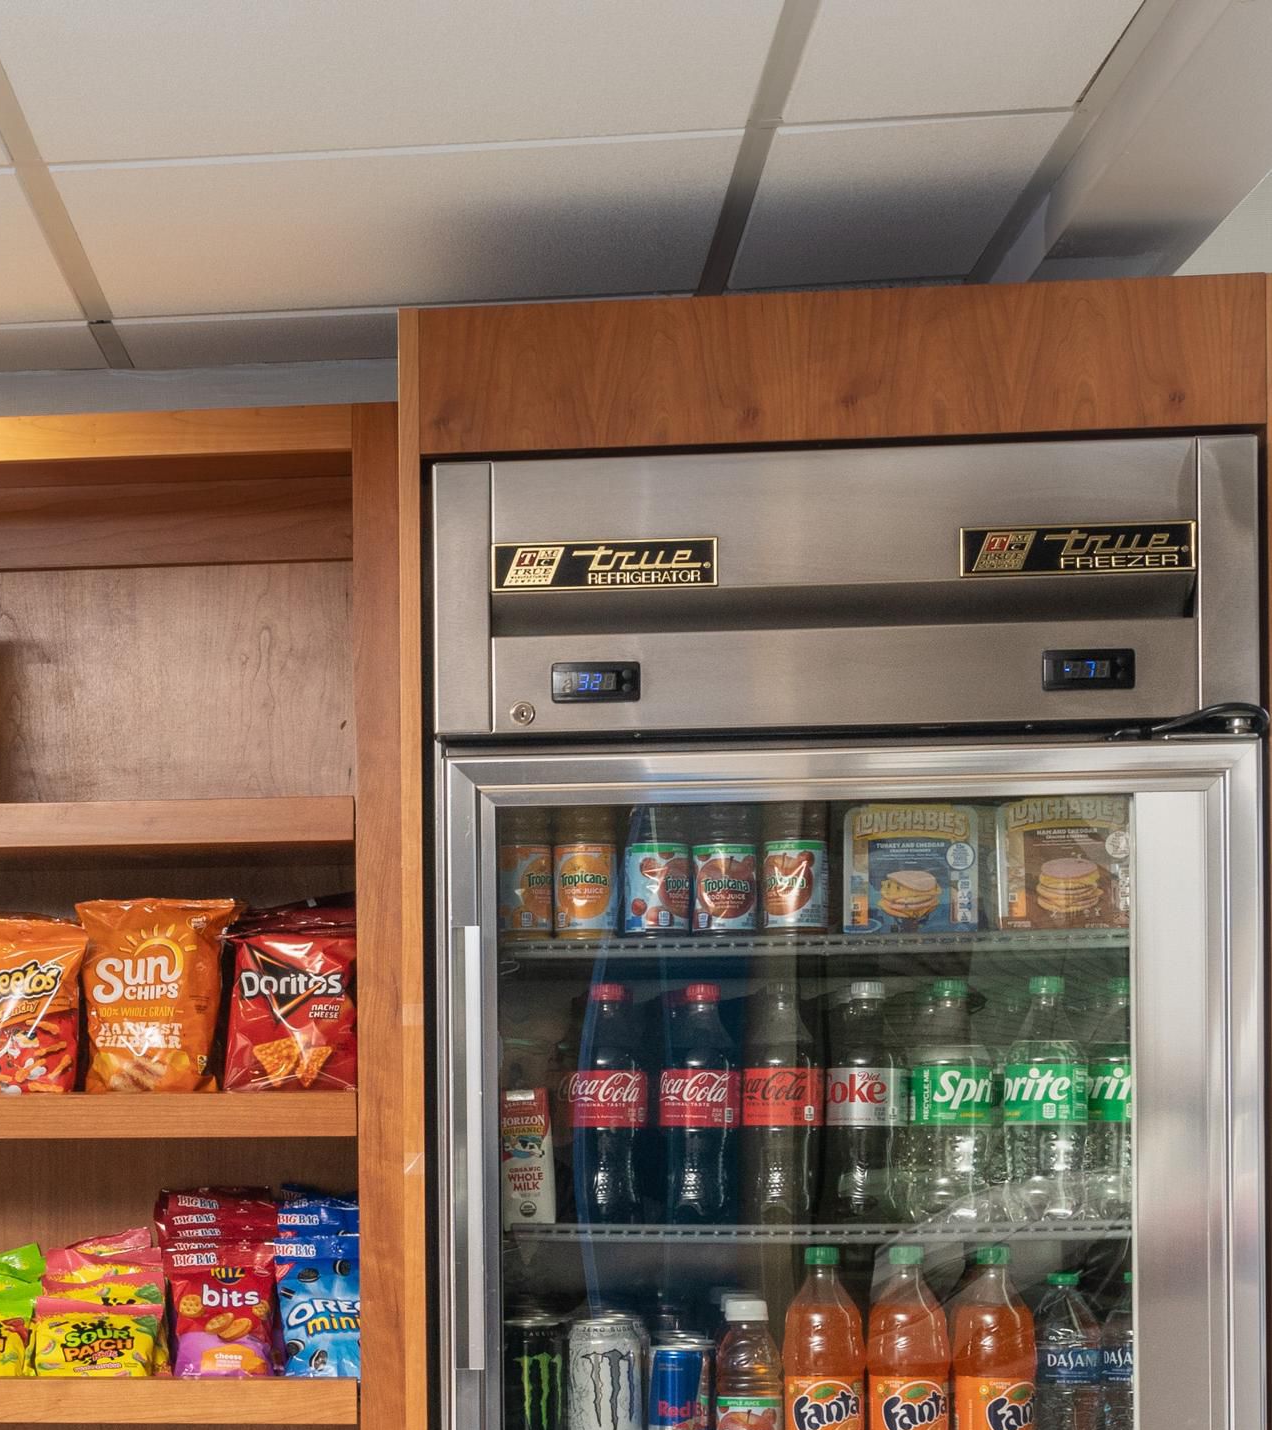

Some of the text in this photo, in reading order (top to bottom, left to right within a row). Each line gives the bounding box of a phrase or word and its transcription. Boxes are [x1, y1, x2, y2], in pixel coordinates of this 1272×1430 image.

[1044, 530, 1178, 555] true
[572, 546, 701, 571] true
[1060, 554, 1179, 569] FREEZER
[588, 570, 700, 584] REFRIGERATOR
[577, 673, 602, 690] 32
[1010, 800, 1127, 827] LUNCHABLES
[856, 808, 969, 839] LUNCHABLES
[561, 872, 608, 887] Tropicana
[704, 879, 750, 893] Tropicana
[92, 954, 183, 1004] Sun
[240, 971, 344, 998] Doritos
[124, 983, 179, 1000] CHIPS
[121, 1007, 146, 1017] WHOLE
[149, 1006, 174, 1016] GRAIN
[308, 1011, 339, 1019] CHEESE
[311, 1004, 340, 1012] NACHO
[569, 1072, 641, 1103] Coca-Cola
[507, 1172, 544, 1182] WHOLE
[513, 1182, 540, 1191] MILK
[172, 1214, 216, 1225] BIG BAG
[278, 1214, 319, 1225] BIG BAG
[273, 1245, 316, 1257] BIG BAG
[172, 1253, 217, 1266] BIG BAG
[202, 1284, 260, 1308] bits
[65, 1328, 129, 1347] SOUR
[62, 1338, 134, 1361] PATCH
[658, 1400, 691, 1416] Red
